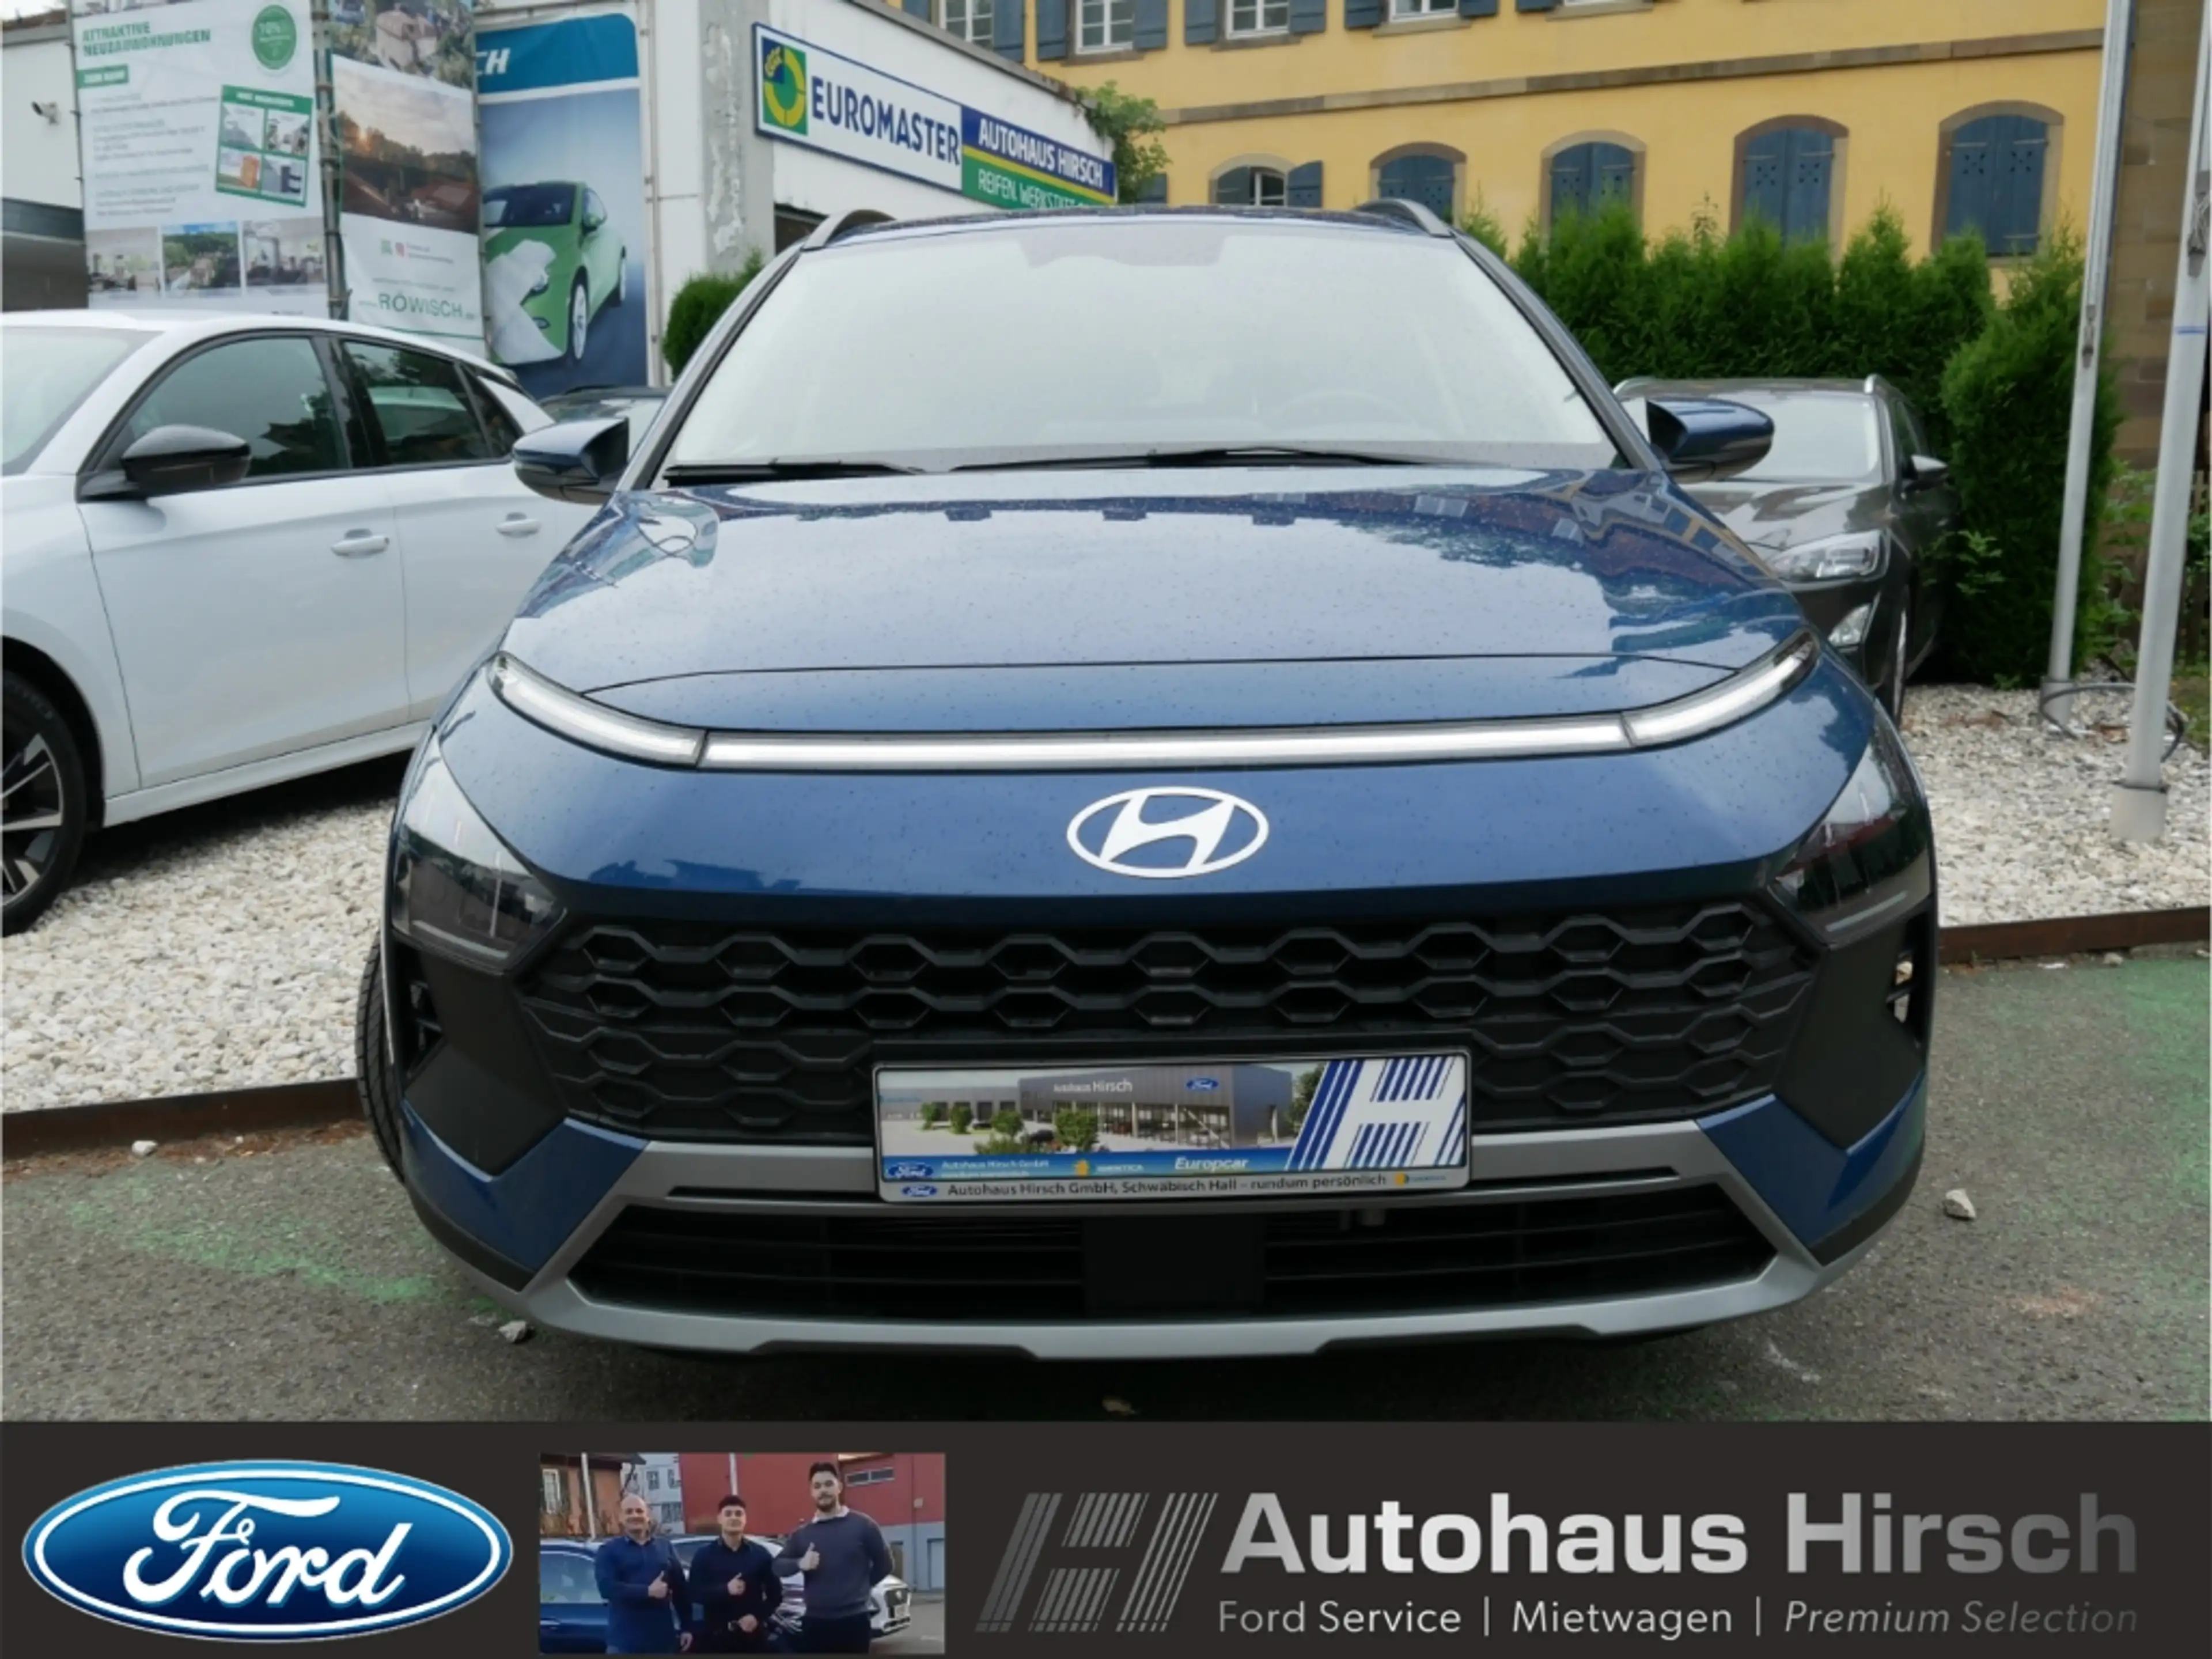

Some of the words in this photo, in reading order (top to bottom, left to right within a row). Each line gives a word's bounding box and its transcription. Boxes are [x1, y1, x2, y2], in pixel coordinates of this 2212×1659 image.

[812, 75, 960, 166] EUROMASTER
[979, 118, 1055, 171] AUTOHAUS
[1058, 147, 1103, 188] HIRSCH
[1093, 1079, 1132, 1093] Hirsch
[1174, 1155, 1249, 1172] Europcar
[948, 1184, 1017, 1196] Autohaus
[1020, 1183, 1065, 1195] Hirsch
[1123, 1180, 1206, 1194] Schwäbisch
[1210, 1179, 1237, 1191] Hall
[1251, 1177, 1308, 1190] rundum
[1313, 1173, 1386, 1191] persönlich
